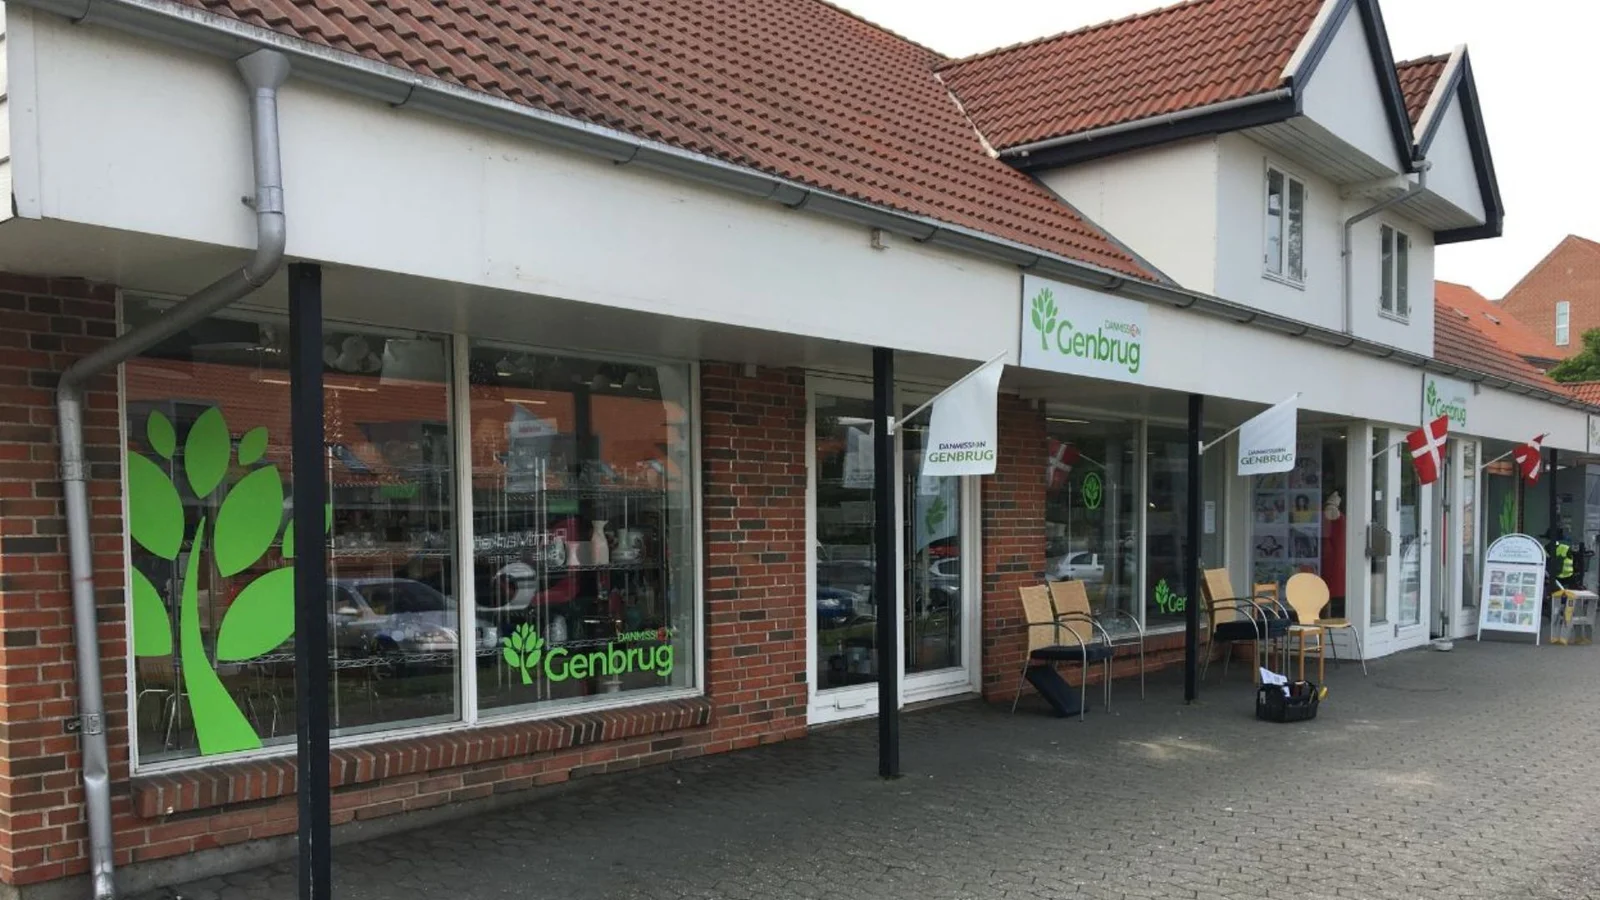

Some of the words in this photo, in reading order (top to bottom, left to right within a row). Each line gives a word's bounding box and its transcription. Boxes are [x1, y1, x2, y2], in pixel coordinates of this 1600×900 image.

[1057, 320, 1140, 374] Genbrug
[928, 450, 994, 463] GENBRUG
[1240, 453, 1293, 465] GENBRUG
[544, 643, 674, 682] Genbrug
